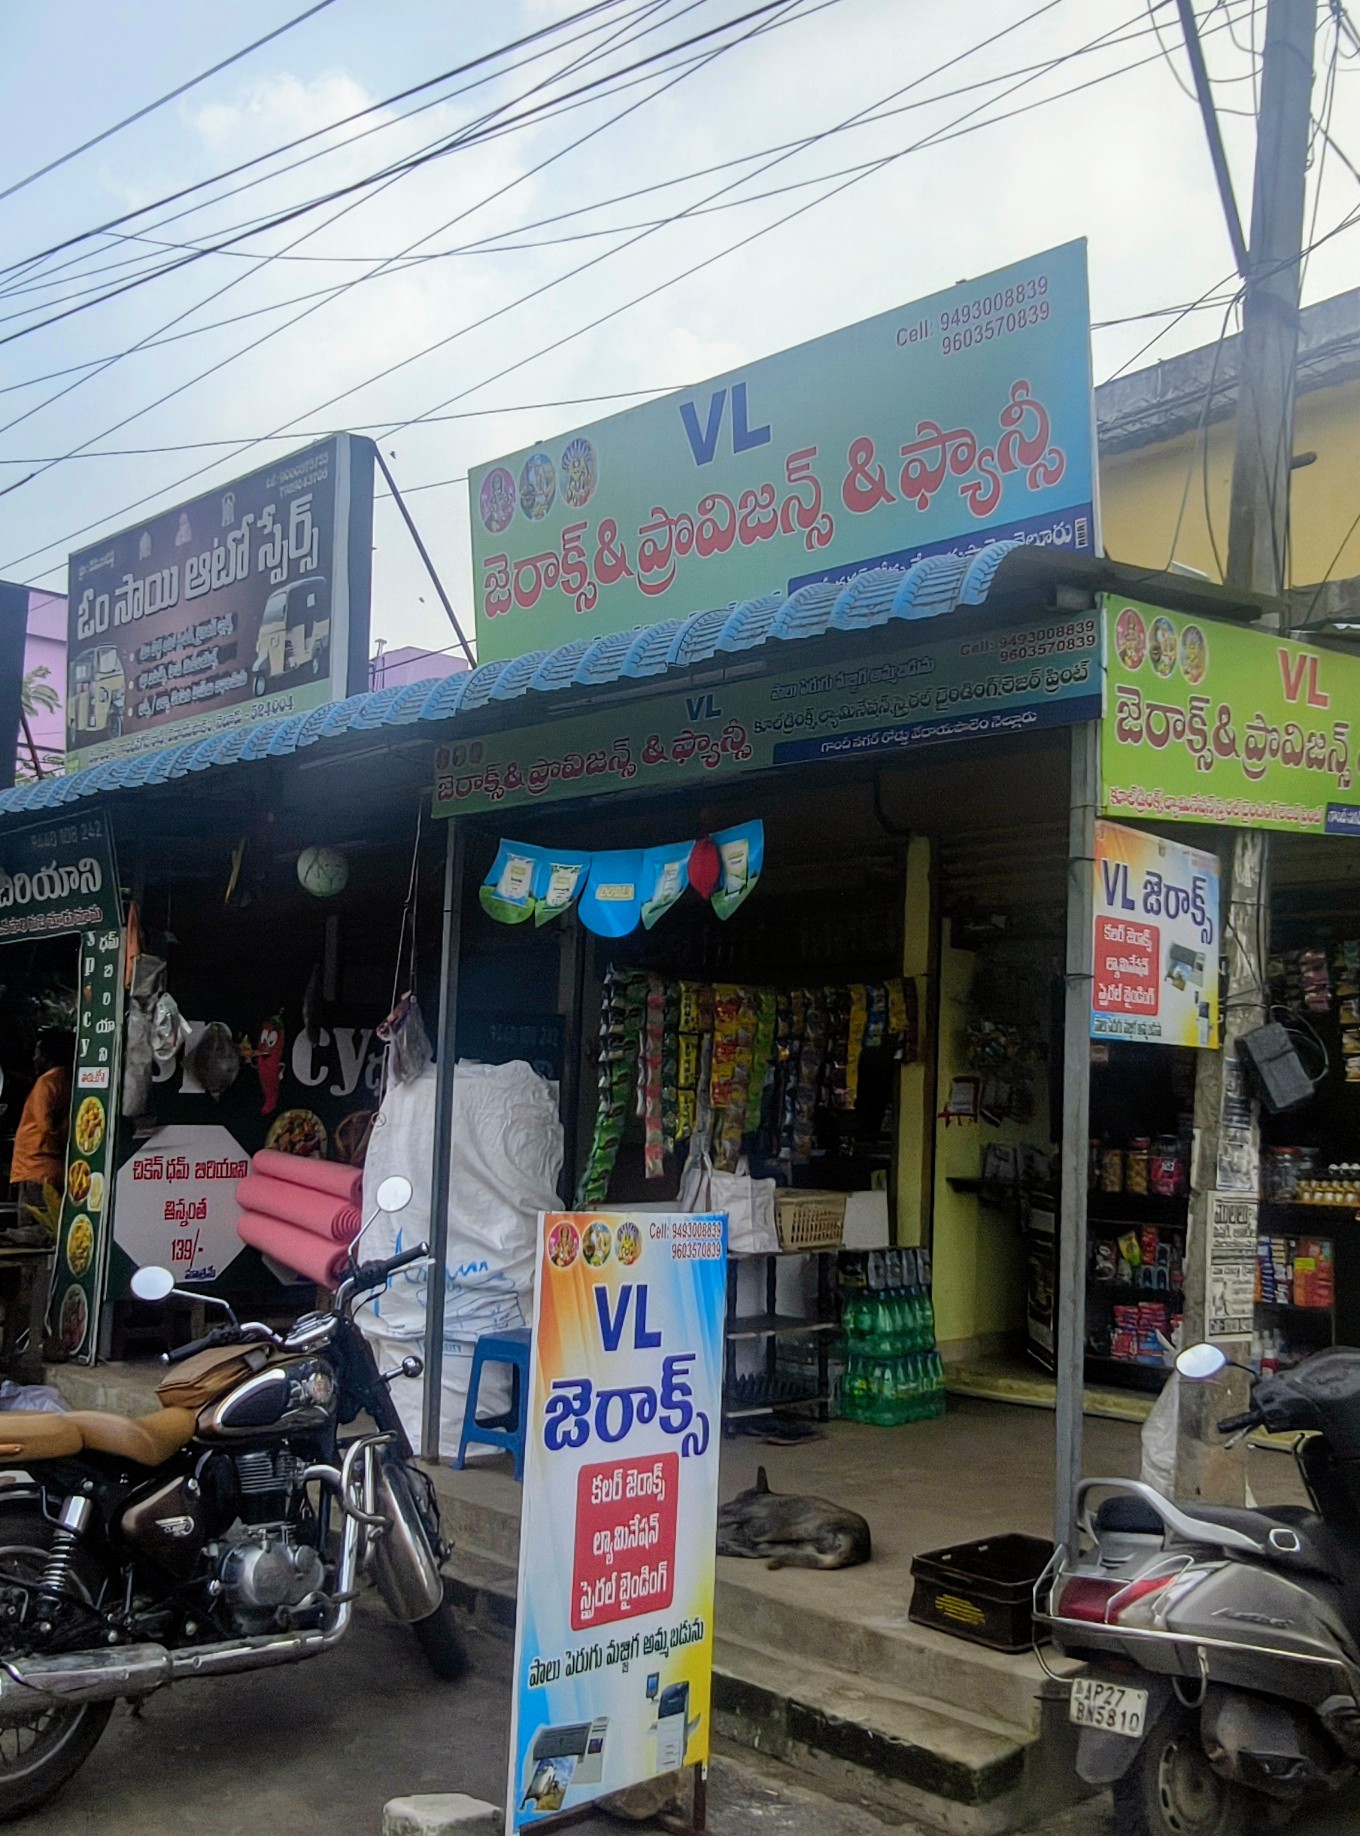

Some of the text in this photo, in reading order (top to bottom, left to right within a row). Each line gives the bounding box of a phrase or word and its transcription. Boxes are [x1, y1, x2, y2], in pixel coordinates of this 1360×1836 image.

[941, 275, 1048, 331] 9493008839
[942, 301, 1050, 355] 9603570839
[680, 381, 771, 466] VL
[842, 436, 897, 514] &
[999, 620, 1094, 648] 9493008839
[1000, 635, 1096, 662] 9603570839
[1278, 648, 1330, 709] VL
[686, 694, 722, 722] VL
[642, 735, 669, 764] &
[1101, 859, 1136, 911] VL
[649, 1221, 722, 1239] Cell: 9493008839
[671, 1241, 722, 1260] 9603570839
[594, 1284, 662, 1351] VL
[544, 1353, 710, 1458] జెరాక్స్
